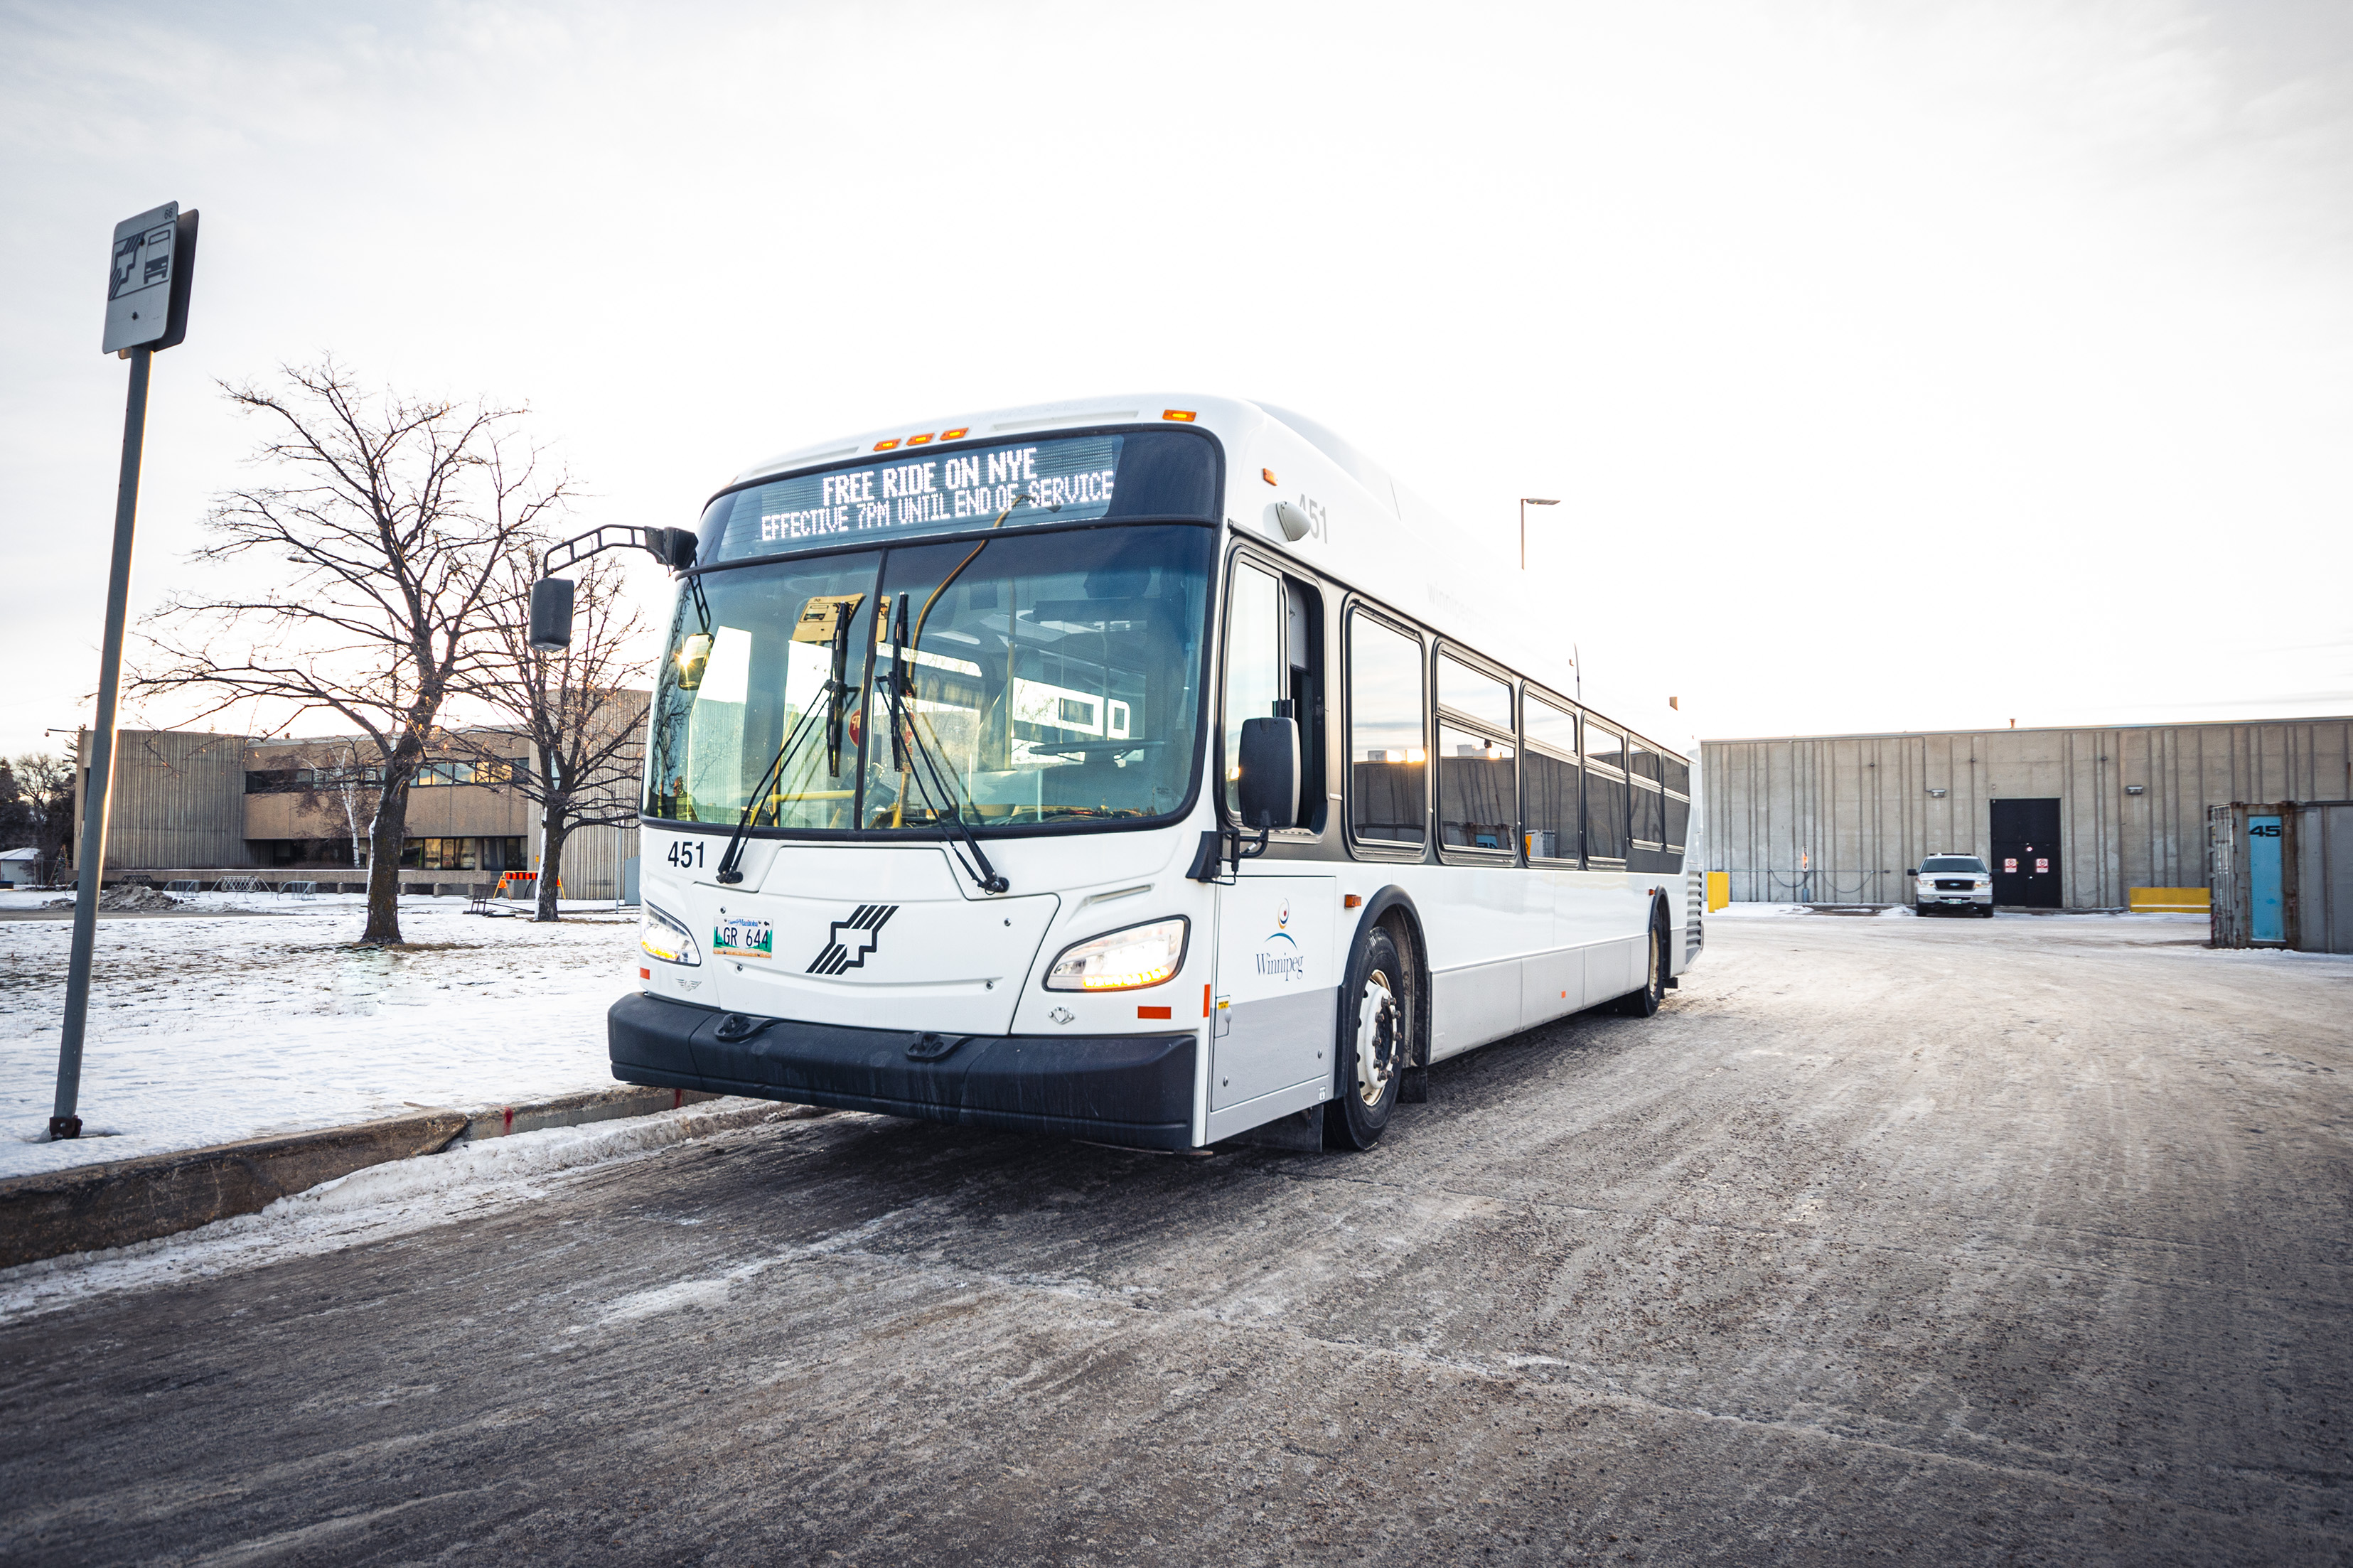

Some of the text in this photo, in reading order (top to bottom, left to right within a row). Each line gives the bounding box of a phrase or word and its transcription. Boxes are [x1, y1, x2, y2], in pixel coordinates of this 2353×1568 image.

[822, 446, 1038, 506] FREE RIDE ON NYE
[761, 471, 1115, 541] EFFECTIVE 7PM UNTIL END OF SERVICE
[2249, 825, 2281, 837] 45
[668, 841, 704, 868] 451
[715, 926, 768, 949] LGR 644
[1256, 952, 1304, 982] Winnipeg
